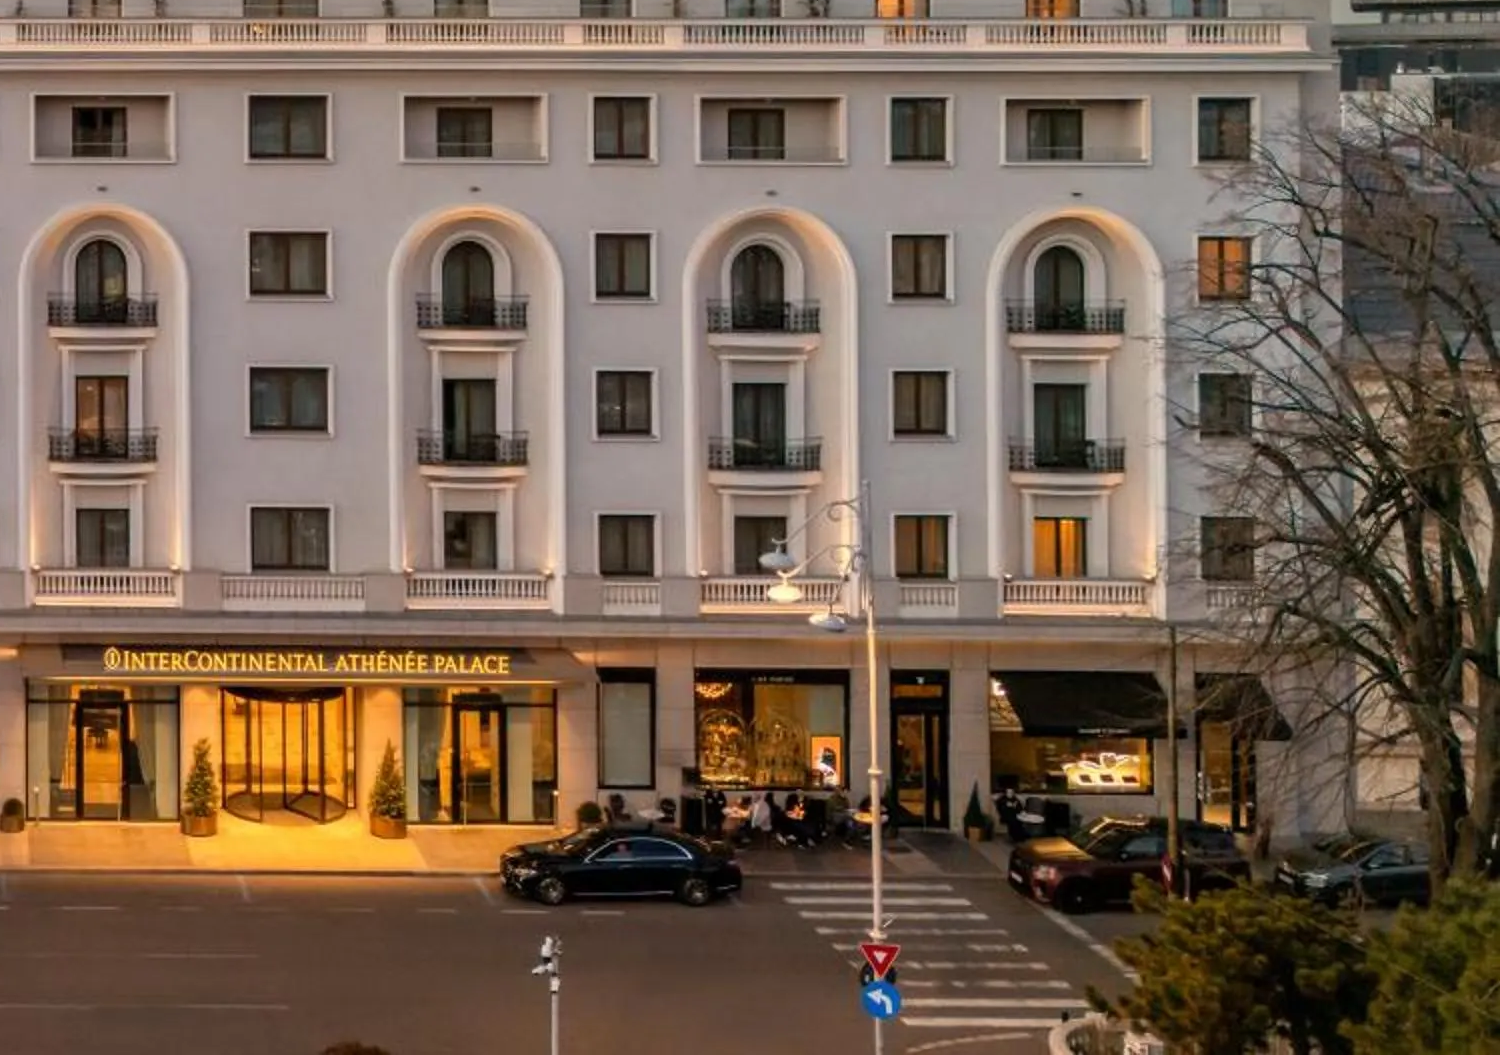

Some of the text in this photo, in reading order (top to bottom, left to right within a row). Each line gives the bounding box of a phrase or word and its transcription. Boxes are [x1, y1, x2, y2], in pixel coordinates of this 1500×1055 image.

[124, 650, 510, 674] INTERCONTINENTAL ATHÉNÉE PALACE
